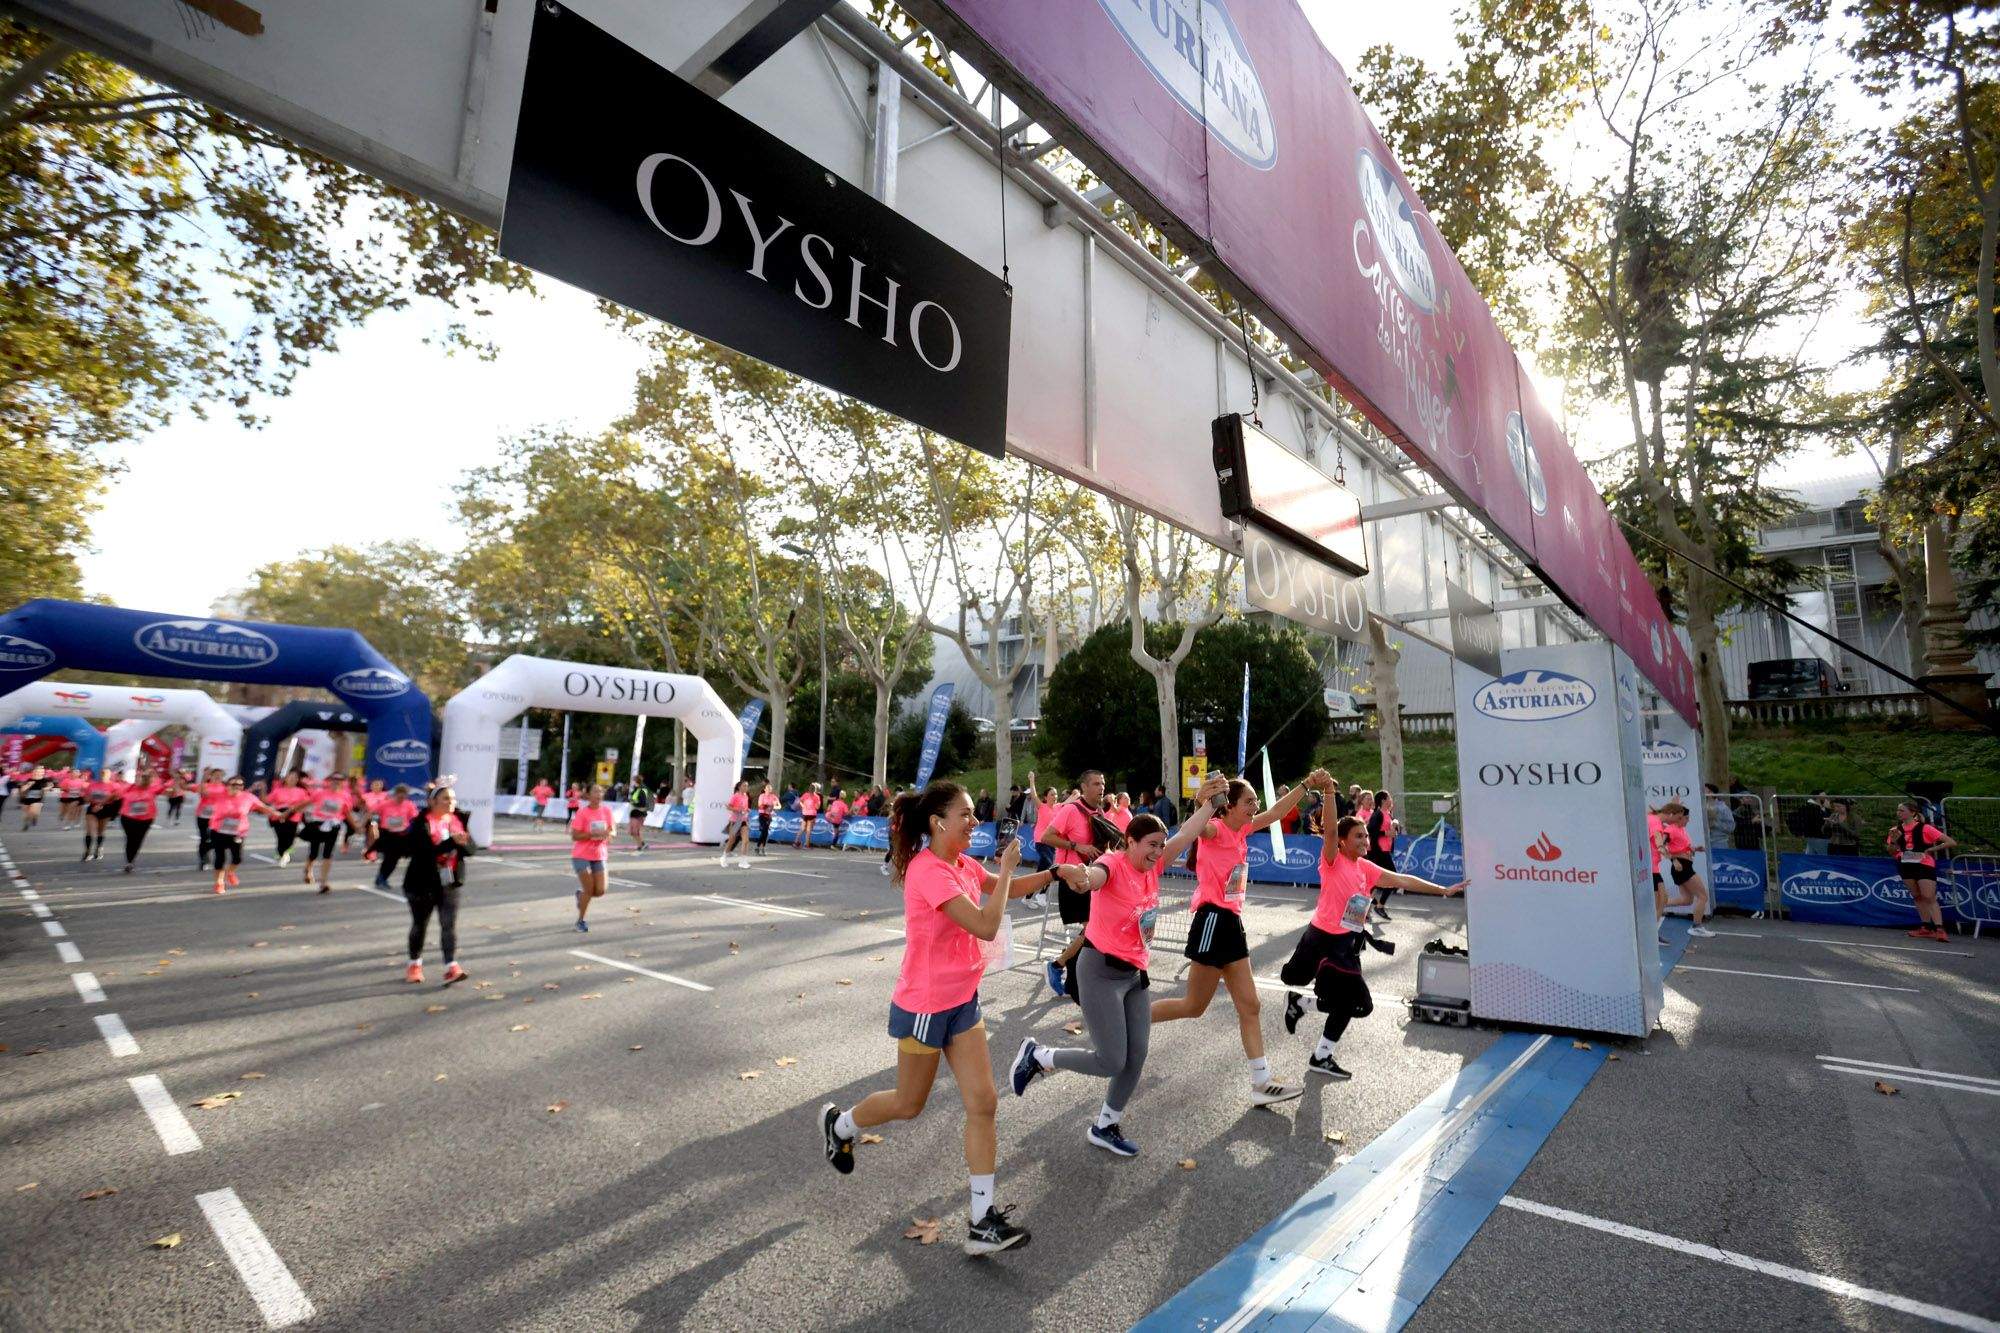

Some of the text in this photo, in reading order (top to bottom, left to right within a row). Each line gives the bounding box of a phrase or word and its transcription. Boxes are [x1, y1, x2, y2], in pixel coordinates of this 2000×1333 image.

[1134, 0, 1266, 155] URIANA
[1364, 169, 1432, 301] ASTURIANA
[635, 151, 963, 373] OYSHO
[1353, 217, 1425, 360] Carrera
[1252, 538, 1364, 633] OYSHO
[145, 629, 268, 662] ASTURIANA
[1458, 612, 1494, 655] OYSHO
[564, 671, 676, 704] OYSHO
[1482, 690, 1587, 711] ASTURIANA
[1478, 761, 1602, 787] OYSHO
[1494, 864, 1599, 884] Santander
[1789, 880, 1865, 897] ASTURIANA
